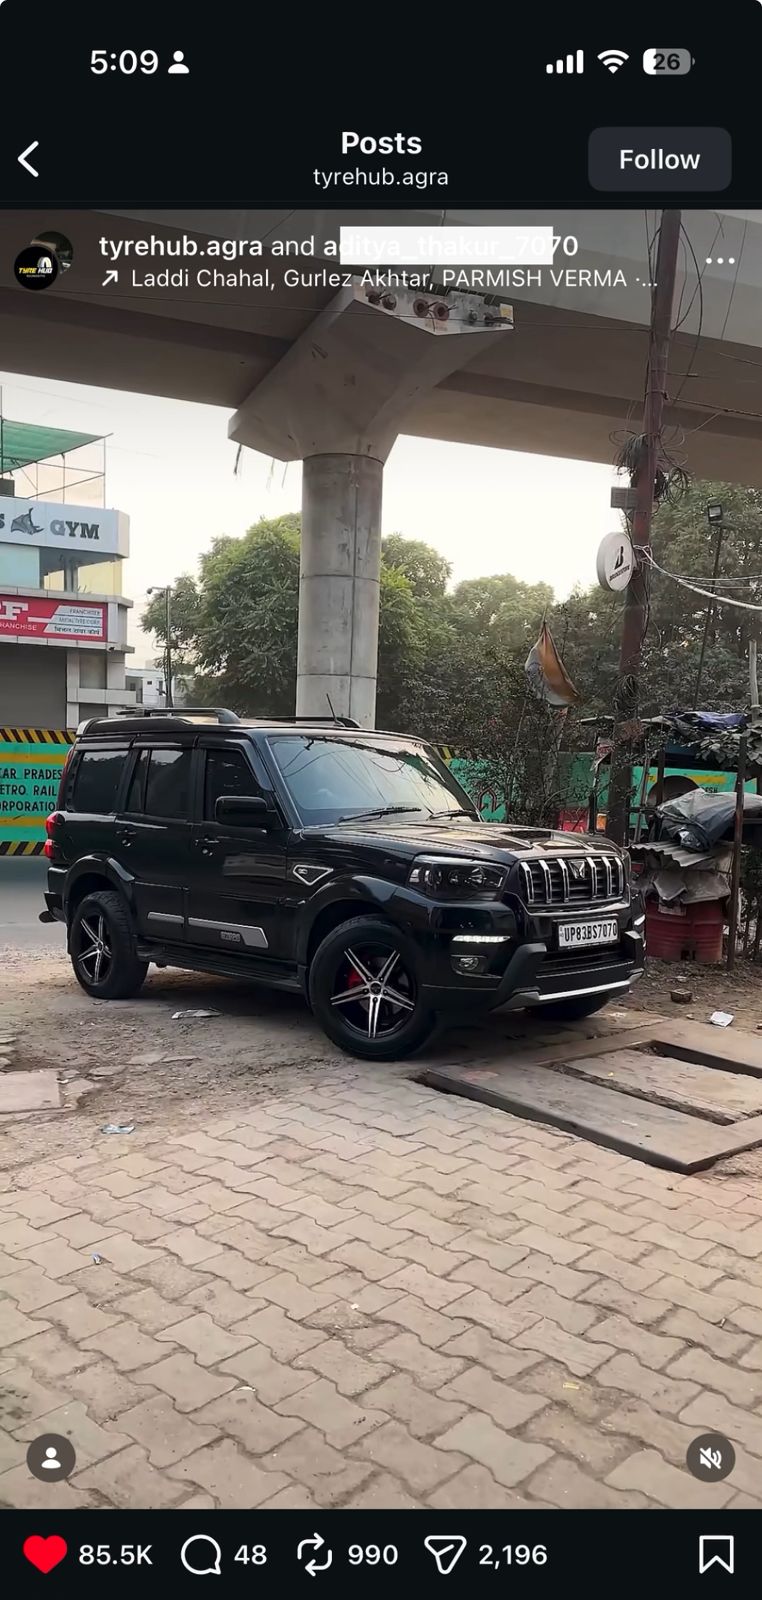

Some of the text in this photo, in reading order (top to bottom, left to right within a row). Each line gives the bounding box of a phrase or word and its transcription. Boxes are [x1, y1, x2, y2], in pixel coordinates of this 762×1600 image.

[50, 519, 100, 540] GYM
[33, 785, 57, 796] RAIL
[0, 800, 56, 812] RPORATIO
[564, 922, 617, 942] UP83BS7070
